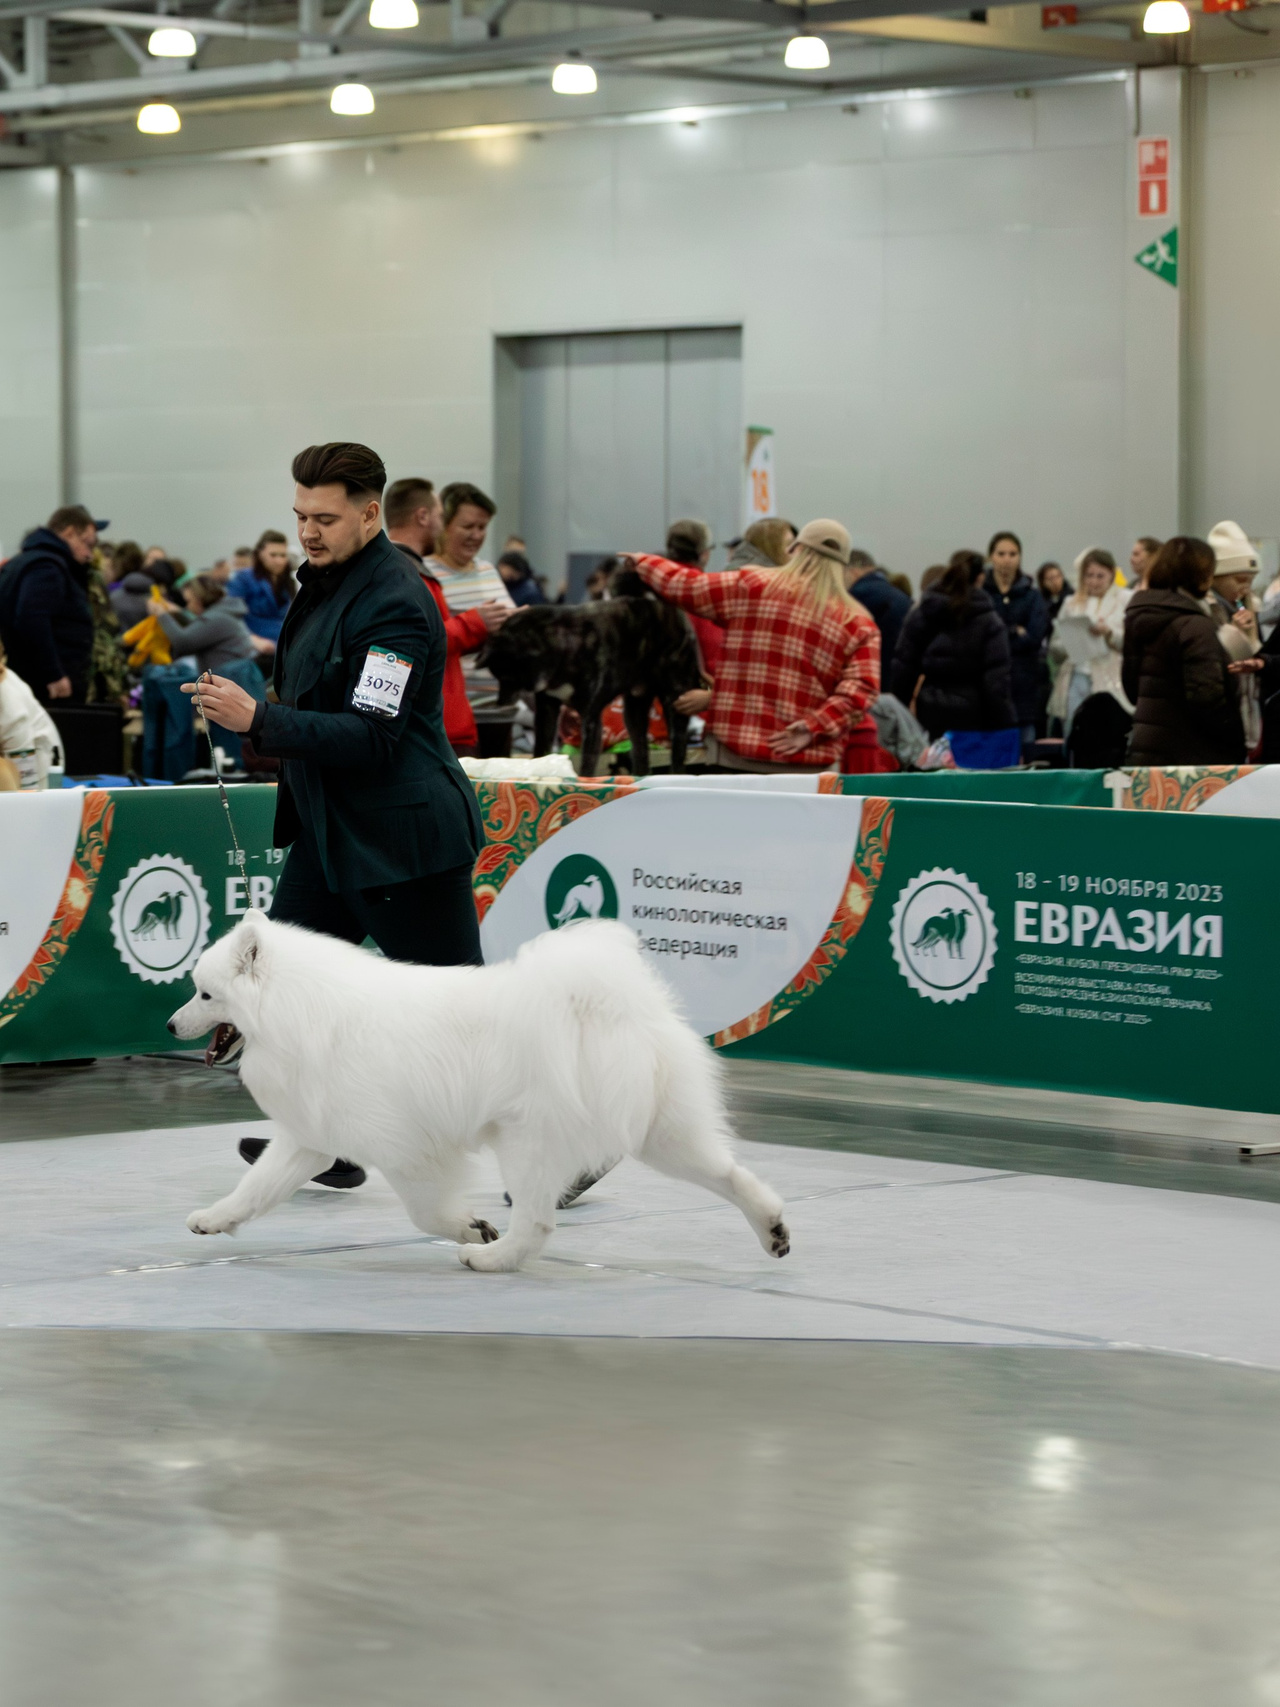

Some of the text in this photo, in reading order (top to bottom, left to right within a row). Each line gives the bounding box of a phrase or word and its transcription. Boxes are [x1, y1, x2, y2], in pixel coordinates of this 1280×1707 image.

[364, 675, 400, 696] 3075
[225, 849, 246, 866] 18
[264, 848, 284, 865] 19
[225, 875, 281, 916] ЕВ
[632, 868, 743, 896] Российская
[1015, 872, 1037, 890] 18
[1058, 875, 1080, 893] 19
[1085, 876, 1169, 899] НОЯБРЯ
[1175, 882, 1224, 903] 2023
[632, 905, 788, 931] кинологическая
[1014, 900, 1223, 958] ЕВРАЗИЯ
